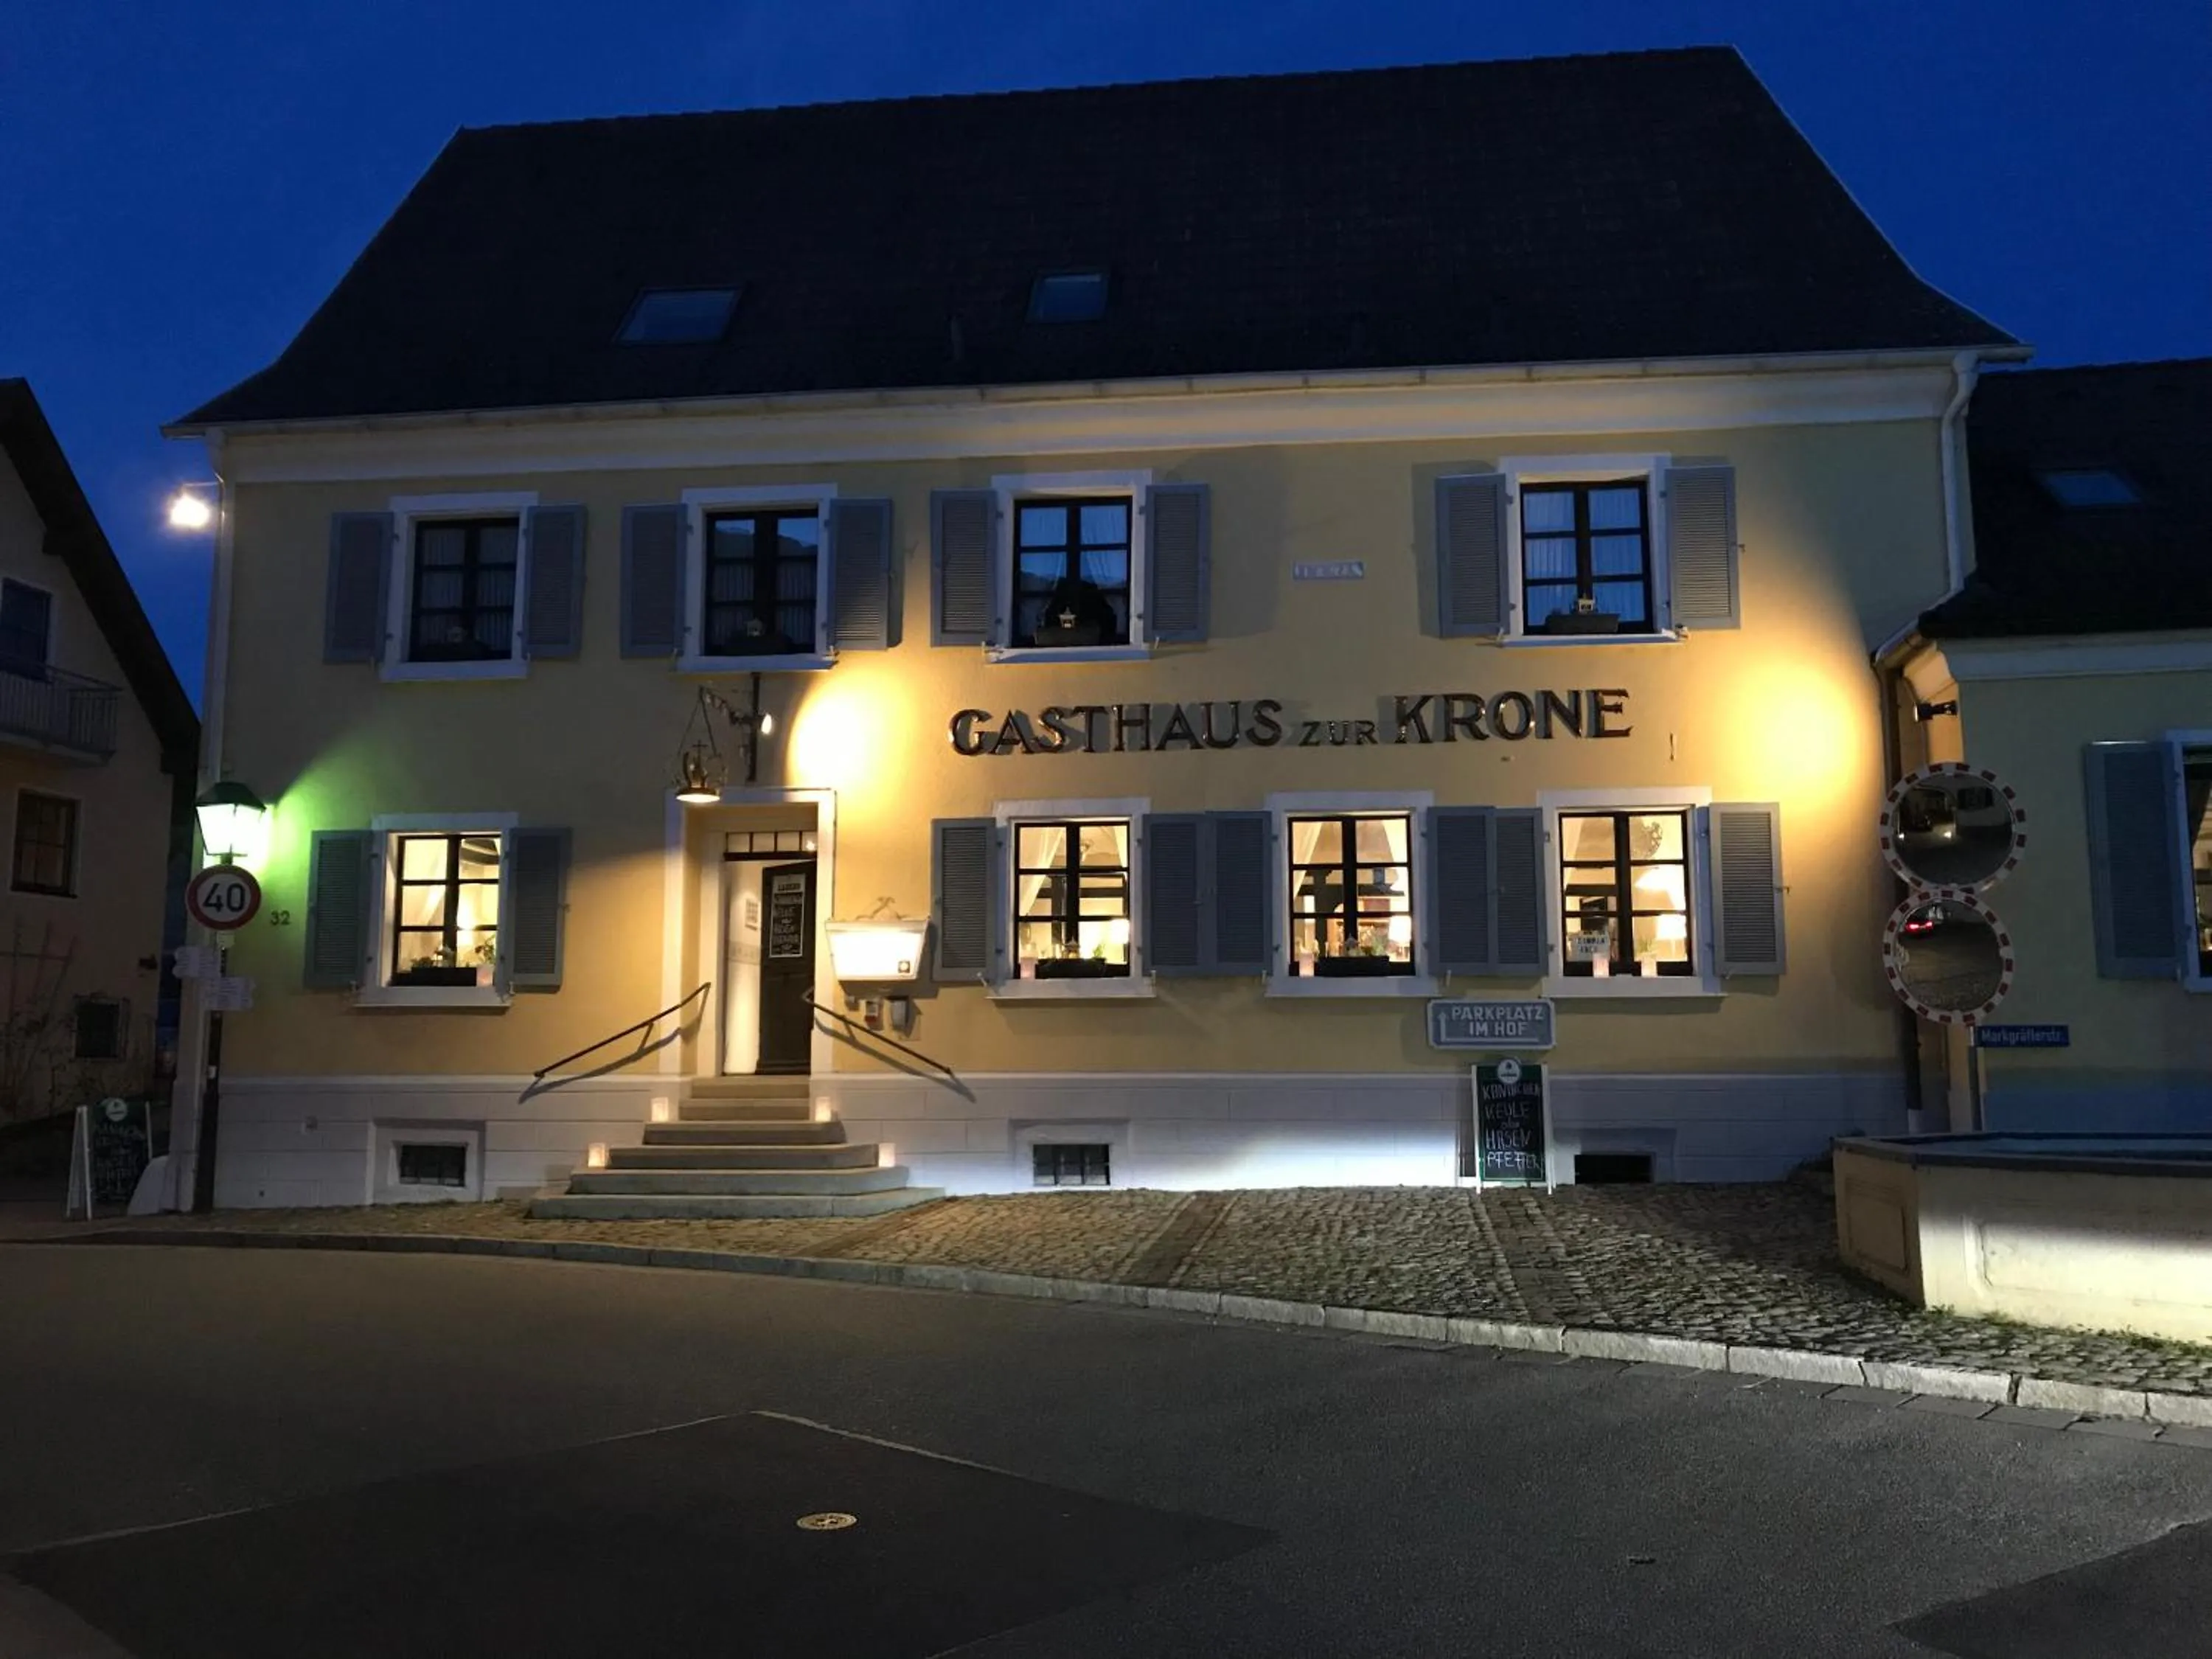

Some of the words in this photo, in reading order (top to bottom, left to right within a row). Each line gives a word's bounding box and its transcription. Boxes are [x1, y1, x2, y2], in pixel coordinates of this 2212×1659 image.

[948, 698, 1283, 756] GASTHAUS
[1298, 720, 1378, 747] ZUR
[1394, 688, 1634, 744] KRONE
[203, 883, 246, 913] 40
[270, 909, 291, 926] 32
[1451, 1005, 1544, 1021] PARKPLATZ
[1470, 1021, 1488, 1036] IM
[1495, 1021, 1528, 1036] HOF
